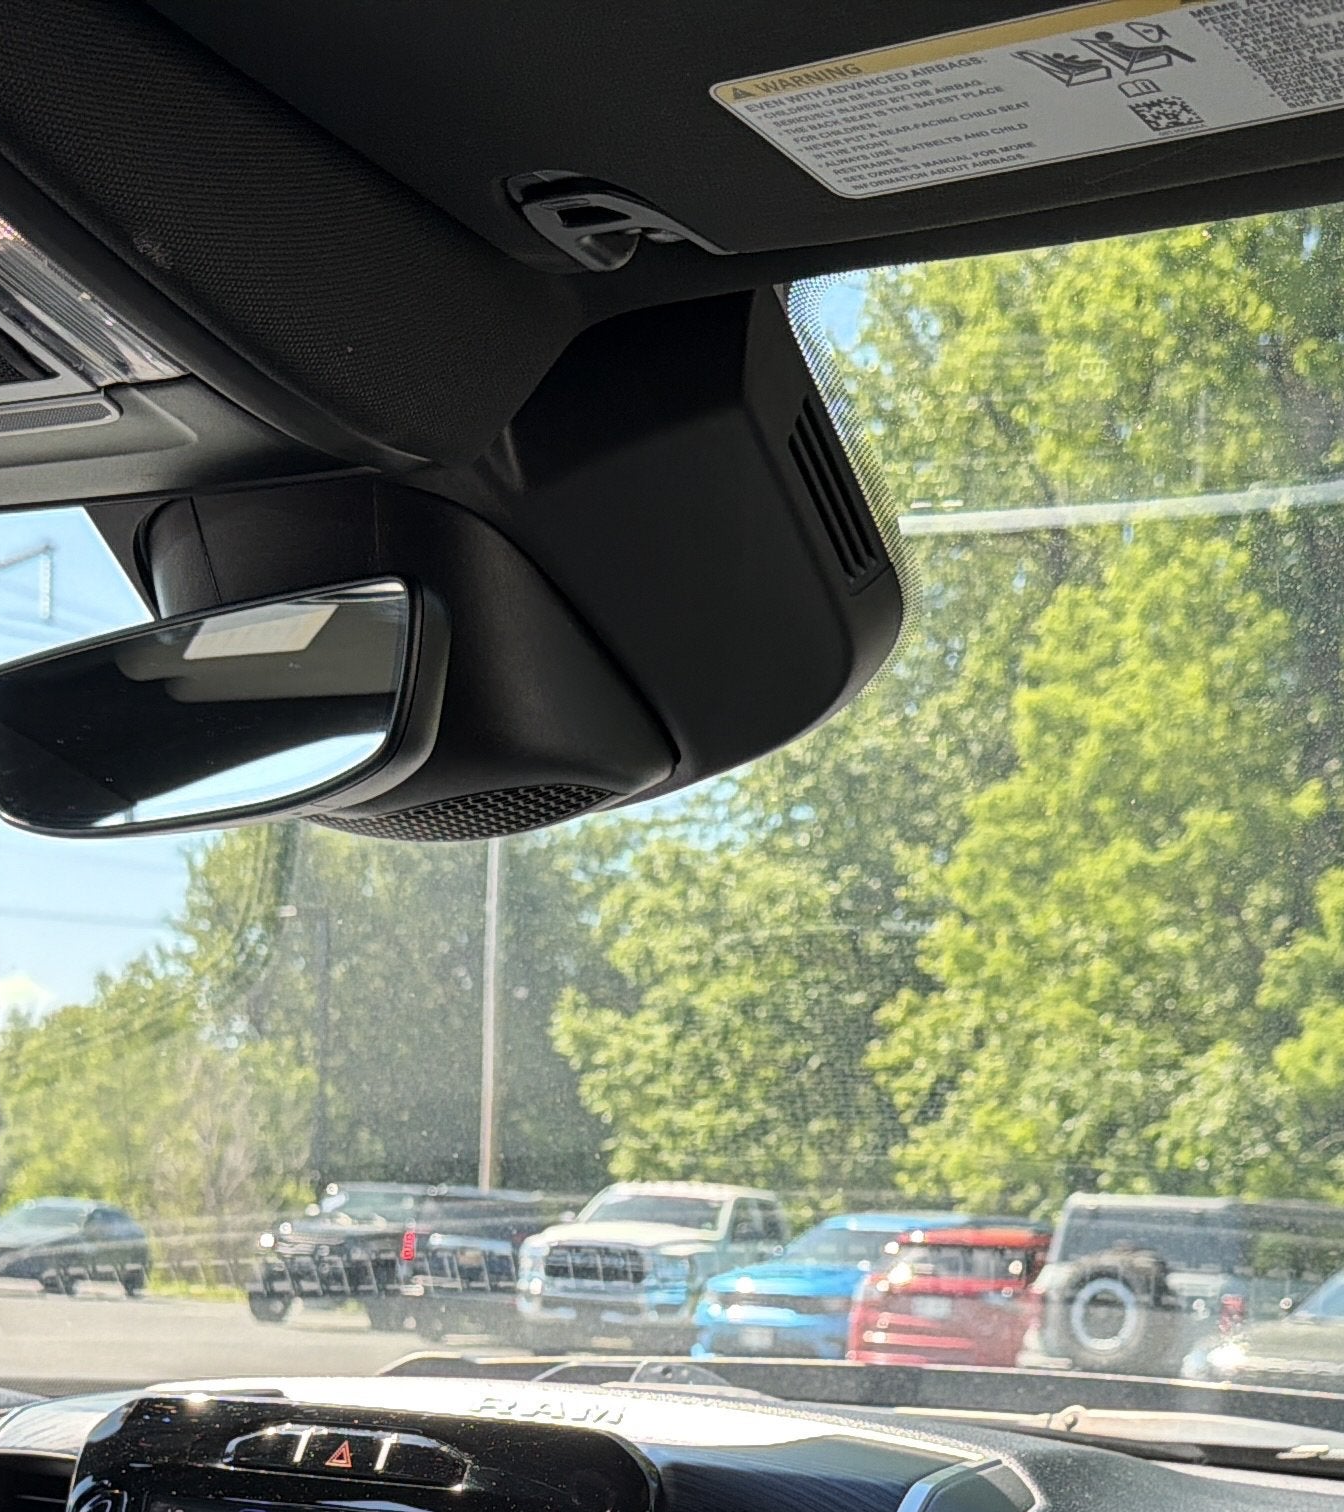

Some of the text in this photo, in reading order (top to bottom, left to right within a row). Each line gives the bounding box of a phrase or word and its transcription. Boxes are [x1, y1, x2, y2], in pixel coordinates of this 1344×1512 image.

[744, 54, 987, 112] EVEN WITH ADVANCED AIRBAGS:
[754, 61, 863, 95] WARNING
[960, 86, 1004, 98] PLACE
[762, 102, 821, 119] CHILDREN
[821, 97, 848, 106] CAN
[867, 83, 912, 97] KILLED
[911, 79, 932, 87] OR
[469, 1397, 627, 1425] RAM
